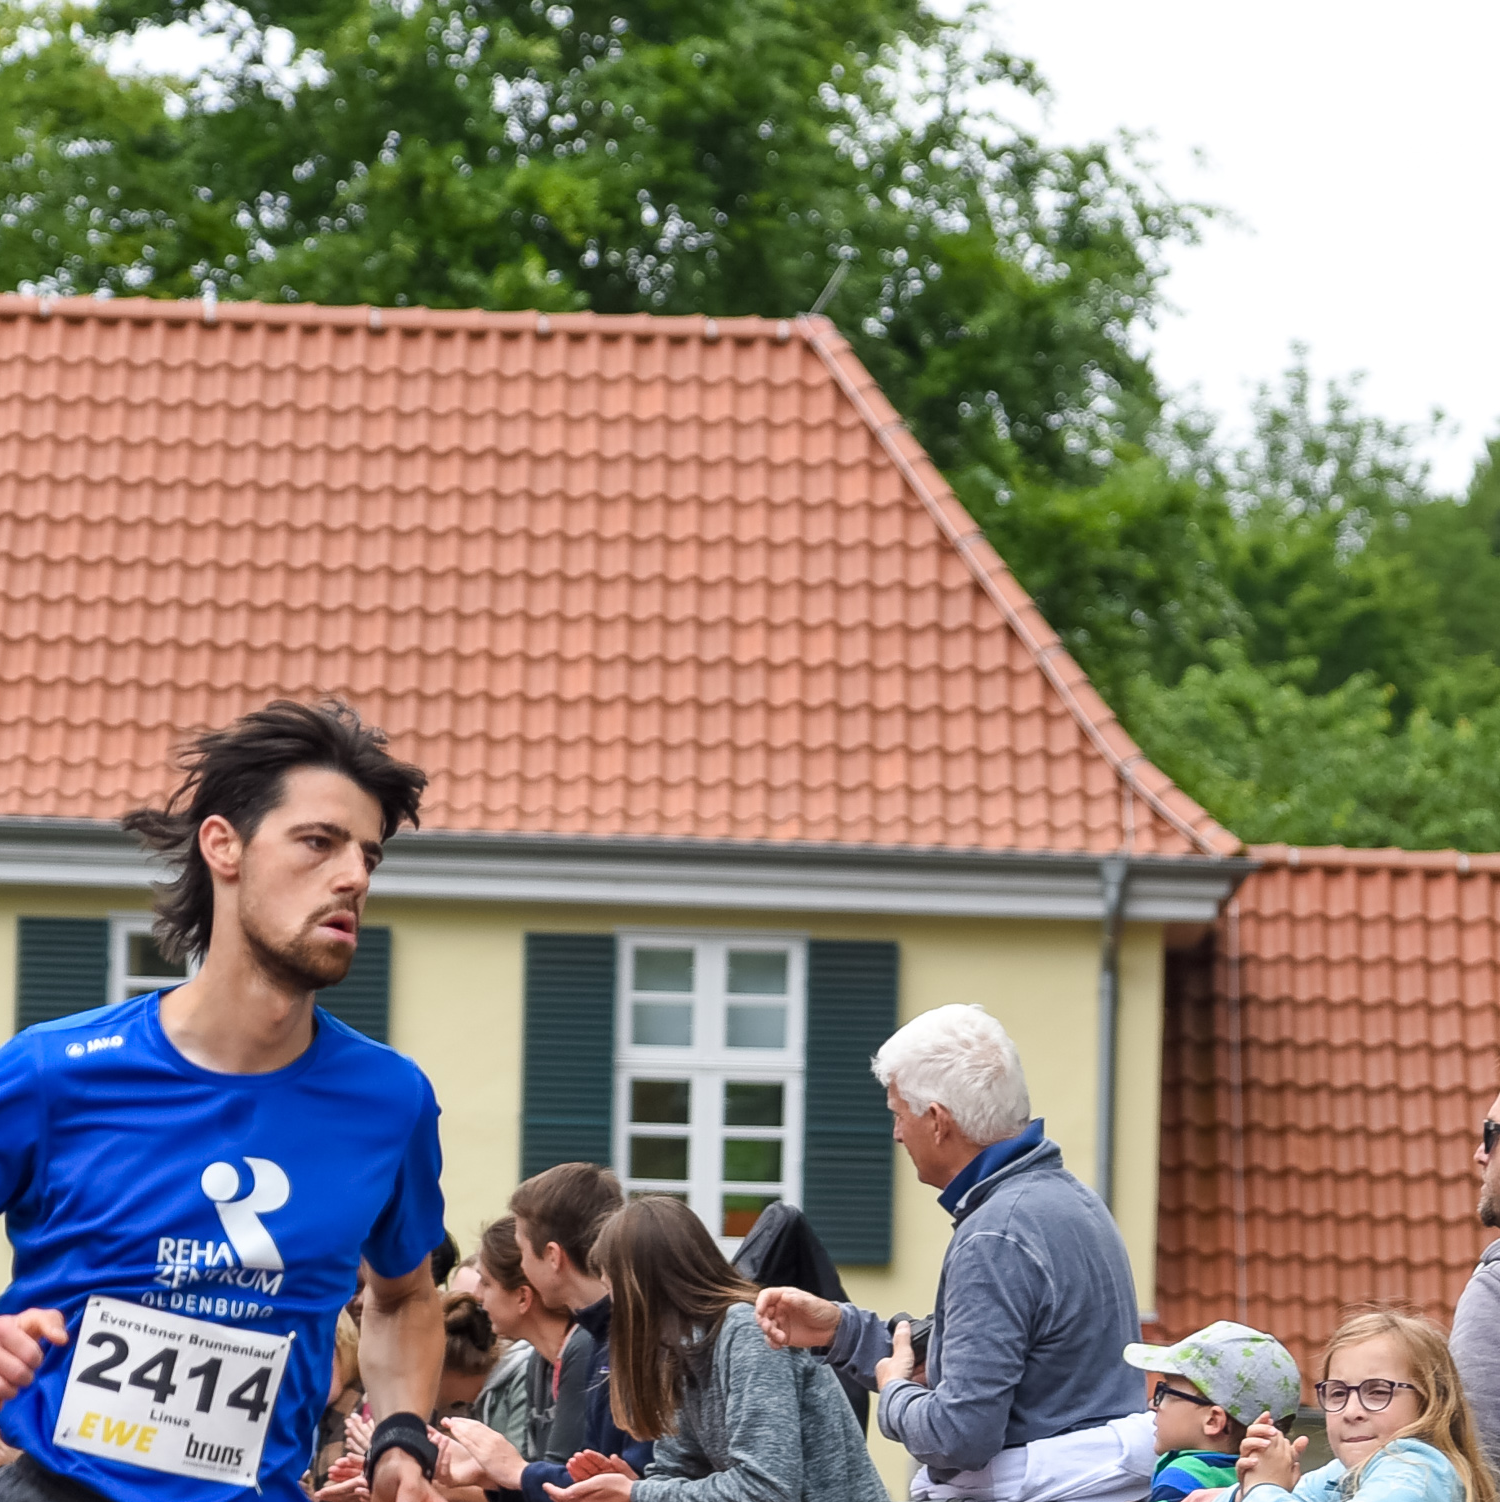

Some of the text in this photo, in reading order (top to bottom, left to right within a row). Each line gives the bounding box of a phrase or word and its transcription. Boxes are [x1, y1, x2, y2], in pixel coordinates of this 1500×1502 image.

[157, 1237, 234, 1267] REHA
[189, 1334, 276, 1360] Brunnenlauf
[76, 1331, 273, 1422] 2414
[78, 1411, 158, 1453] EWE
[150, 1409, 191, 1428] Linus
[185, 1432, 245, 1466] bruns
